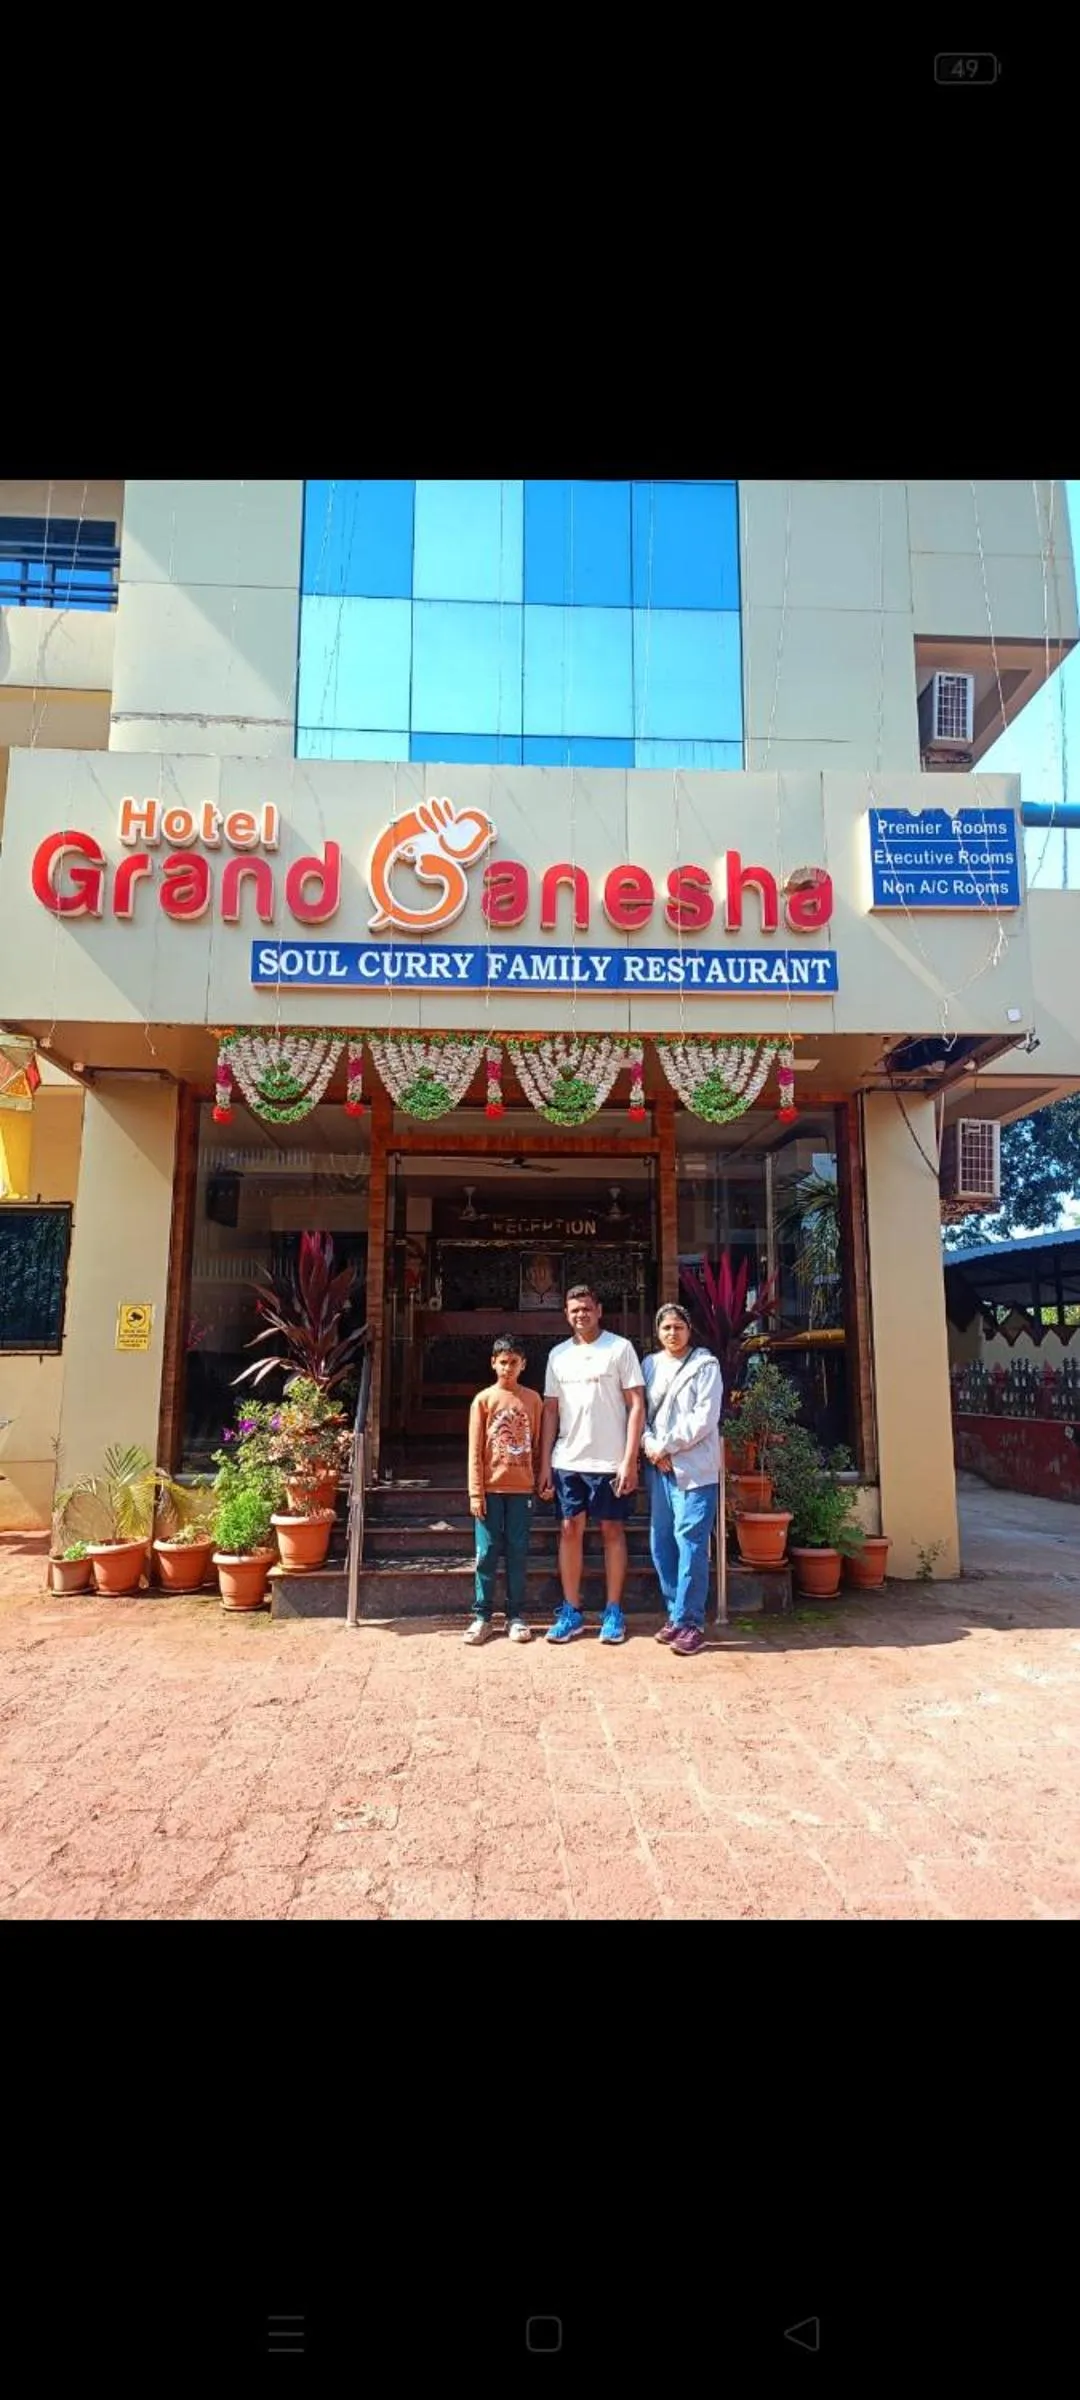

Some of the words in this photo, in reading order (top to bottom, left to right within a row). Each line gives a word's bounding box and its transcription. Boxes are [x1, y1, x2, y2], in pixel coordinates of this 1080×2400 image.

[118, 796, 279, 851] Hotel
[877, 819, 942, 835] Premier
[951, 819, 1008, 835] Rooms
[874, 849, 954, 865] Executive
[958, 850, 1014, 865] Rooms
[32, 828, 343, 924] Grand
[882, 880, 915, 894] Non
[919, 879, 948, 894] A/C
[953, 880, 1009, 894] Rooms
[258, 948, 349, 978] SOUL
[358, 950, 475, 979] CURRY
[486, 952, 612, 983] FAMILY
[623, 954, 832, 985] RESTAURANT
